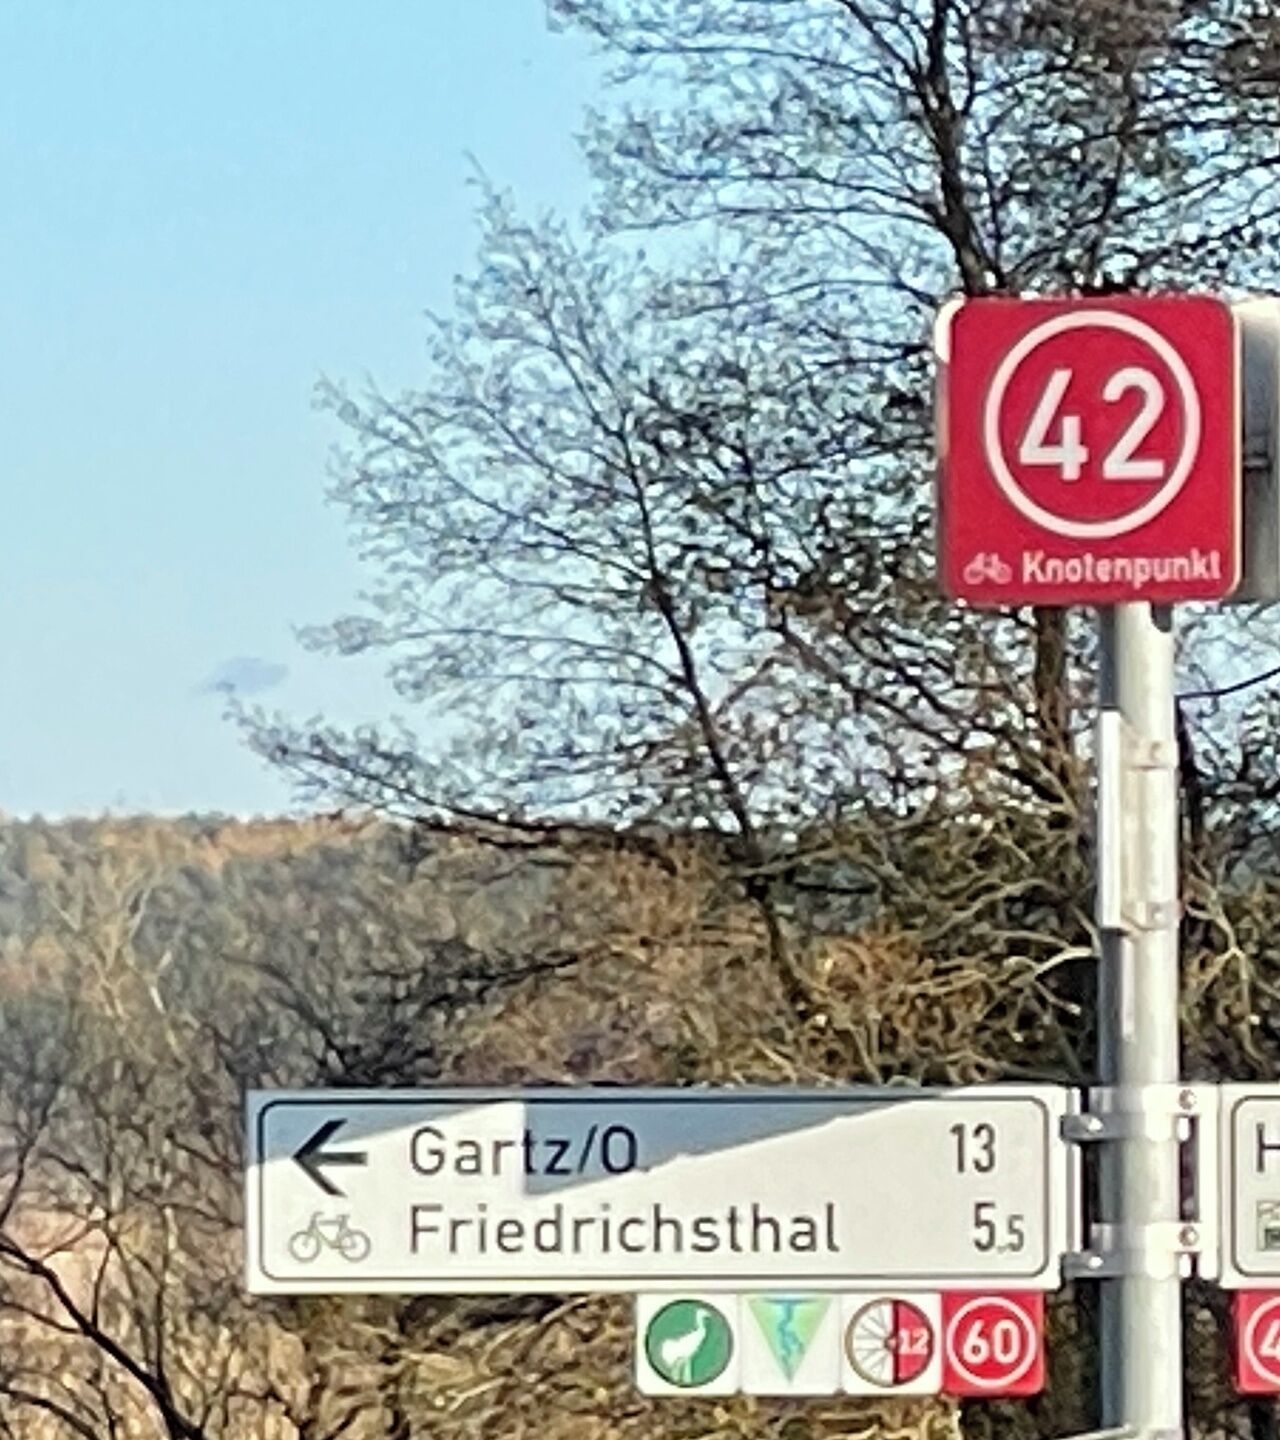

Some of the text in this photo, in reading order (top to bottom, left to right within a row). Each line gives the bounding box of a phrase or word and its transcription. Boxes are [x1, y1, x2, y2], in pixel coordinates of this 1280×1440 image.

[1019, 367, 1166, 480] 42
[1022, 548, 1221, 590] Knotenpunkt
[950, 1123, 995, 1174] 13
[410, 1202, 840, 1254] Friedrichsthal
[897, 1328, 929, 1356] 12
[963, 1320, 1021, 1366] 60
